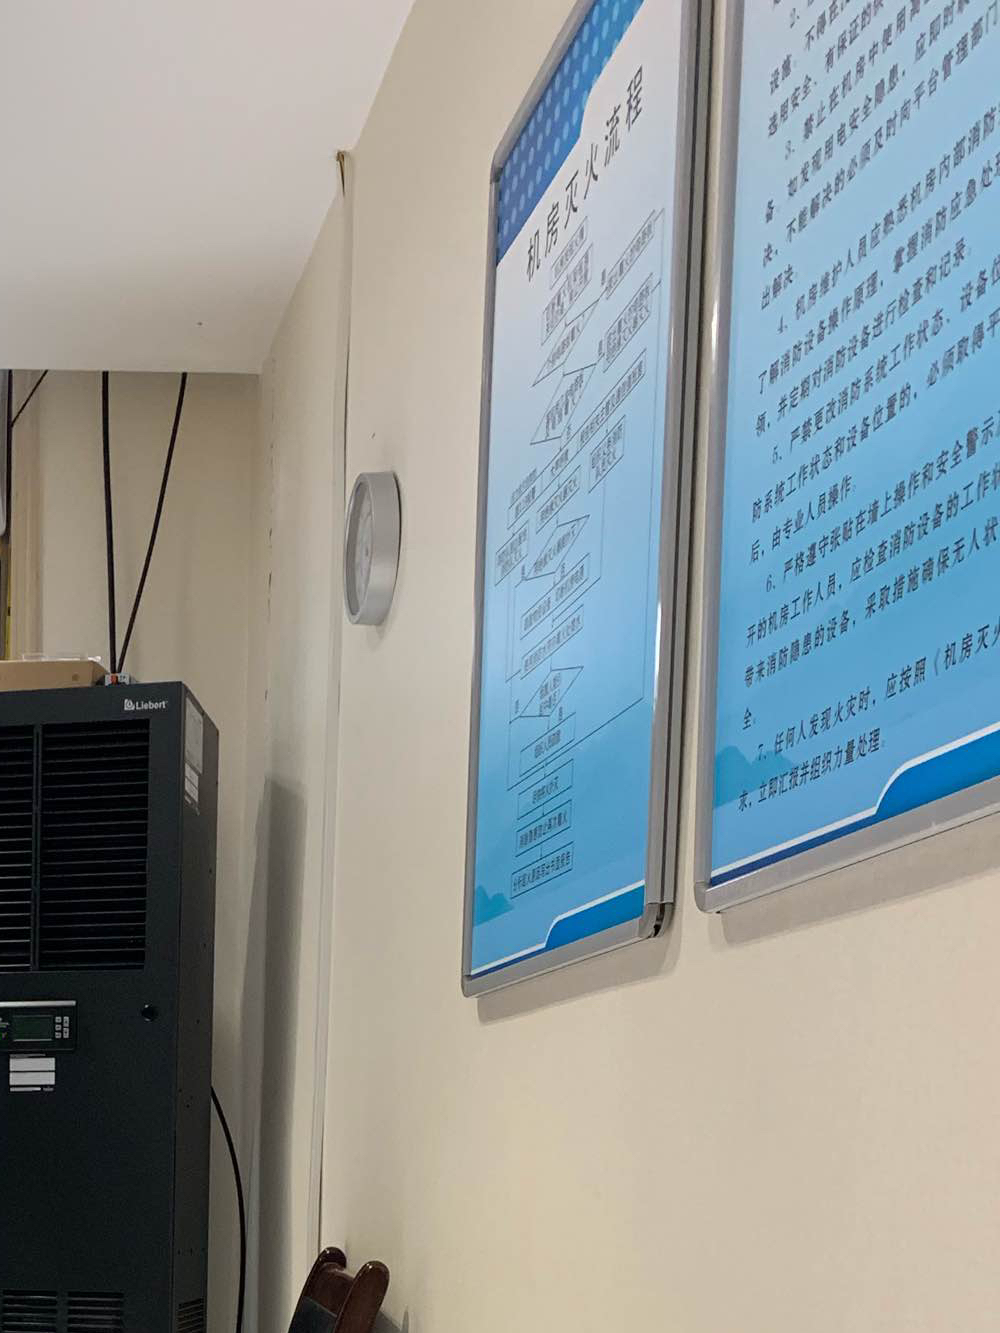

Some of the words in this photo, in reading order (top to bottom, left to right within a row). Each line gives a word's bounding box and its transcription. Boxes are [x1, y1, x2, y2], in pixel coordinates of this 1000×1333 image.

[527, 66, 642, 282] 机房灭火流程
[777, 104, 1000, 334] 4、机房维护人员应熟悉机房内部消防
[766, 409, 1000, 592] 6、严格遵守张贴在墙上操作和安全警示
[135, 700, 166, 710] Liebert
